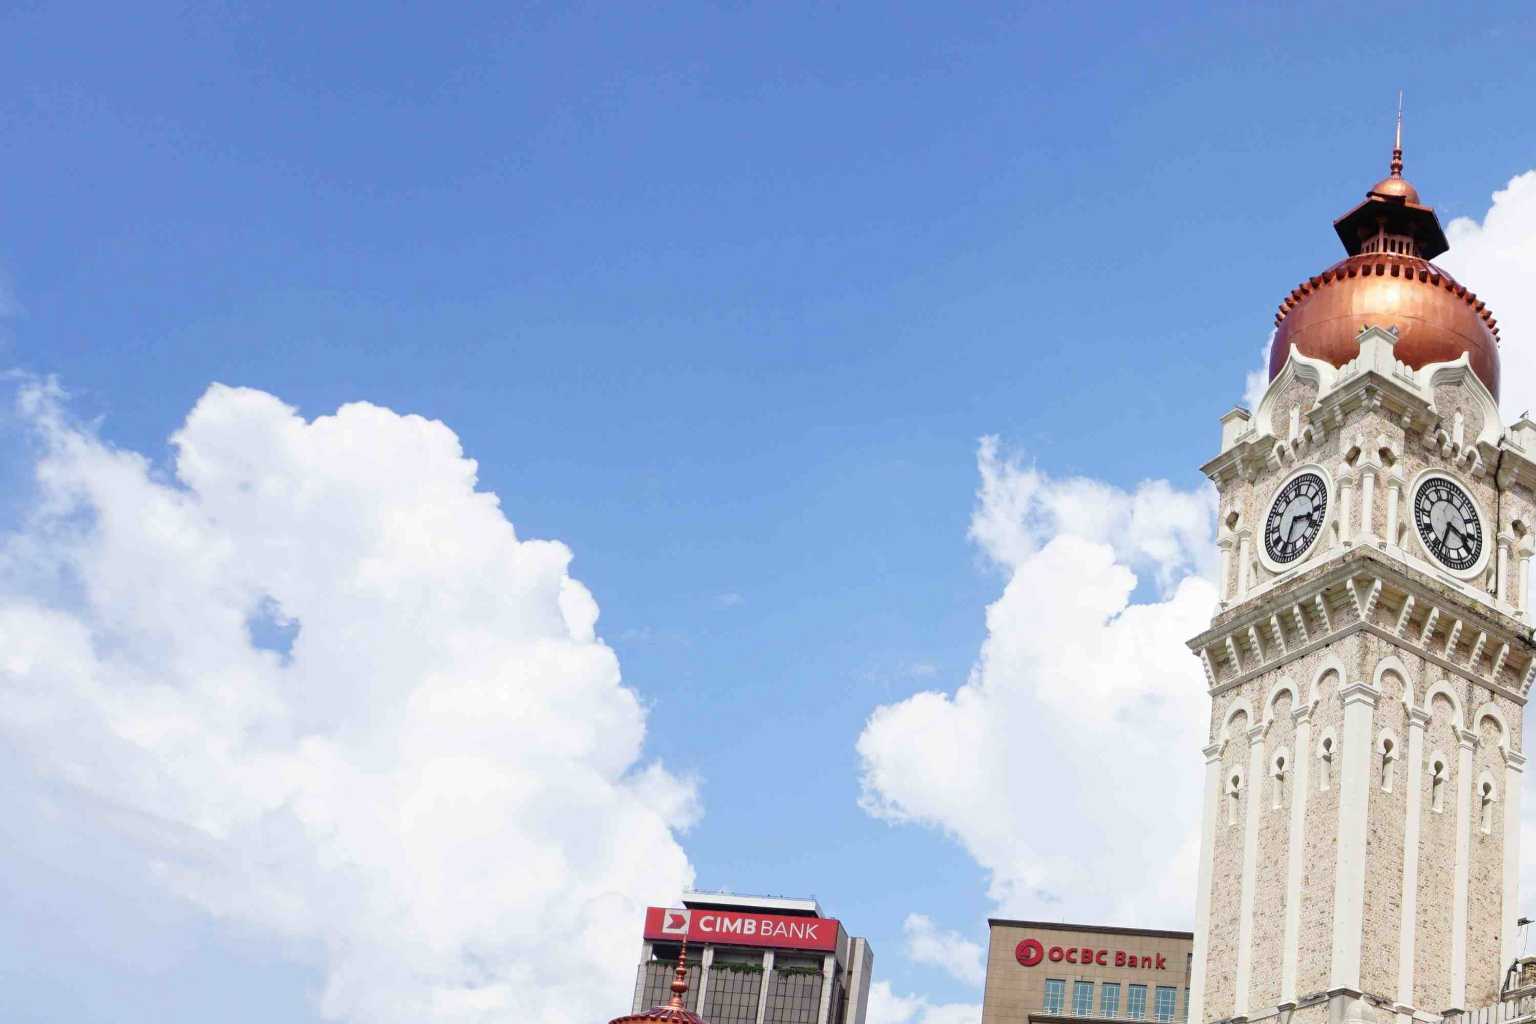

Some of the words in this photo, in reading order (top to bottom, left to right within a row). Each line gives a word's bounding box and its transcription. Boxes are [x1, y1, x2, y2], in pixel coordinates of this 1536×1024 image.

[699, 915, 757, 935] CIMB
[760, 920, 819, 940] BANK
[1048, 946, 1108, 966] OCBC
[1115, 950, 1166, 970] Bank
